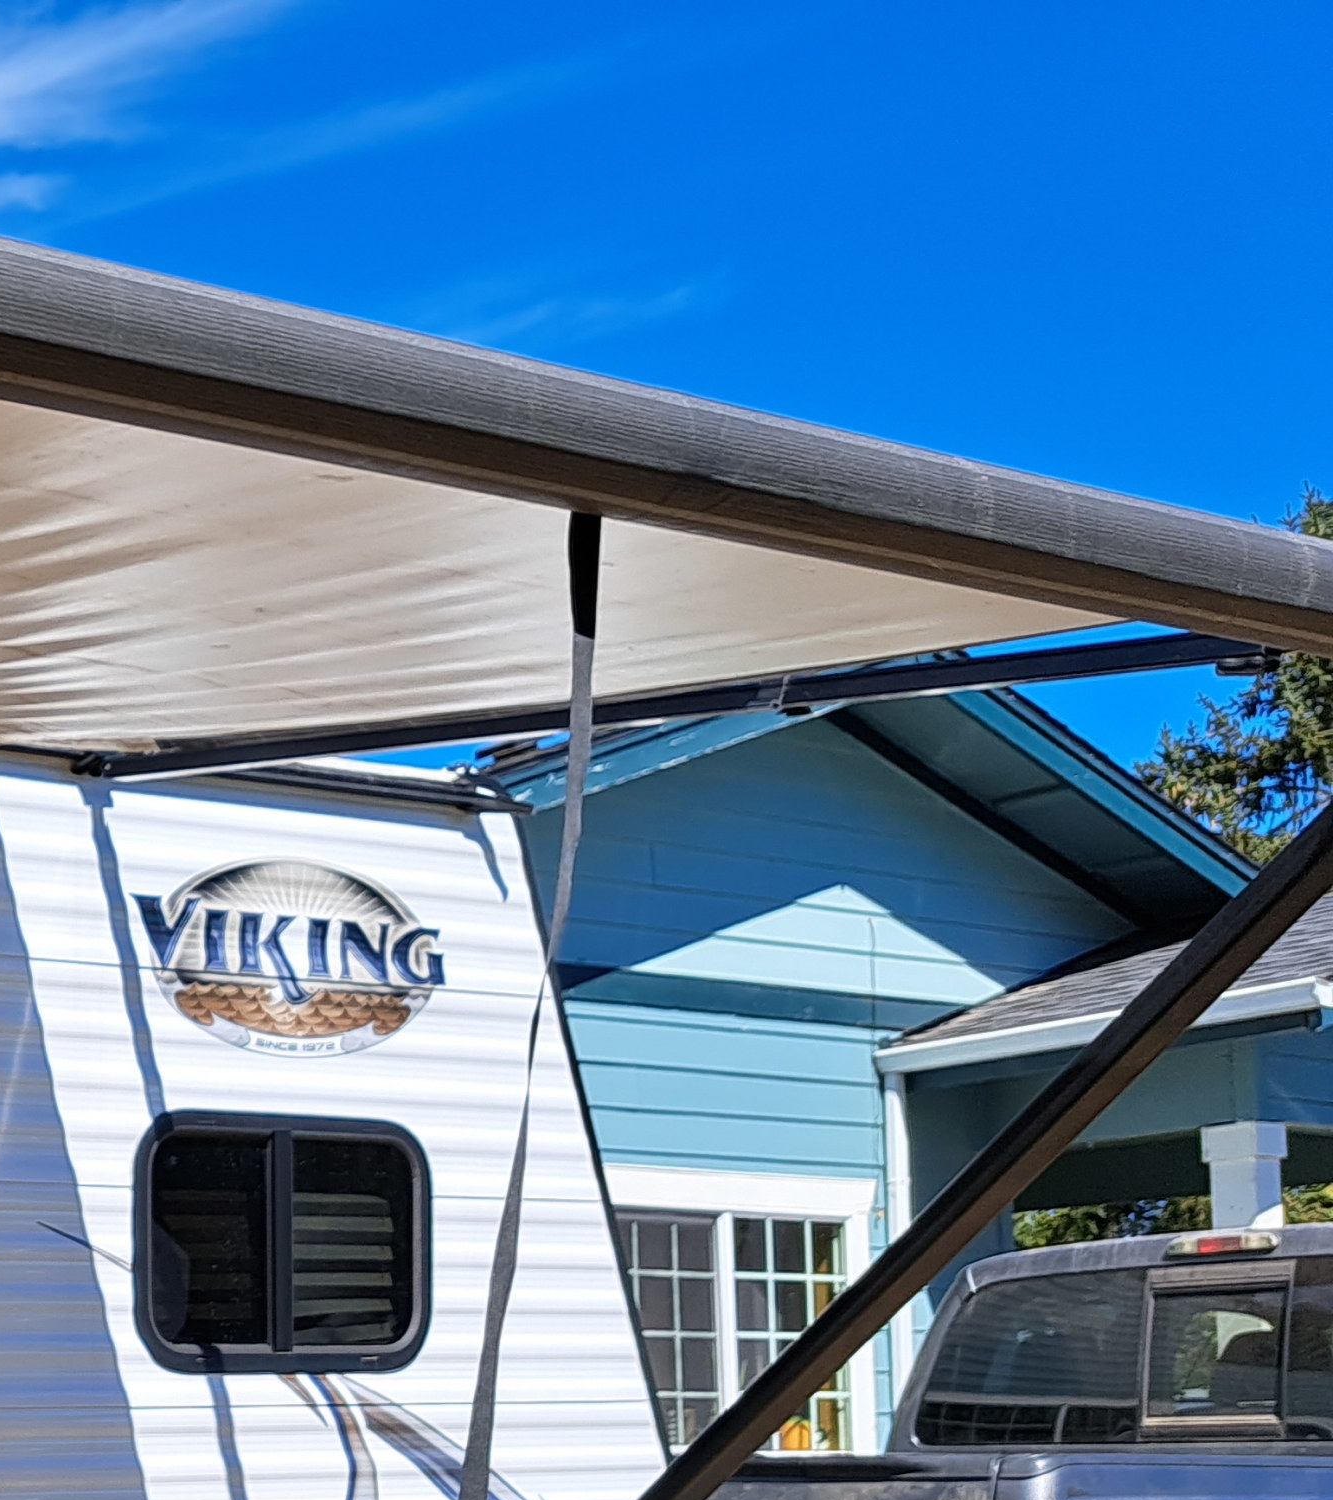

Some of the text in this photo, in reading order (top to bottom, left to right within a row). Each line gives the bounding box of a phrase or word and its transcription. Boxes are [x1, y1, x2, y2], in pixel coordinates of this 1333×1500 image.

[130, 894, 446, 1004] VIKING
[255, 1038, 335, 1051] SINCE 1972
